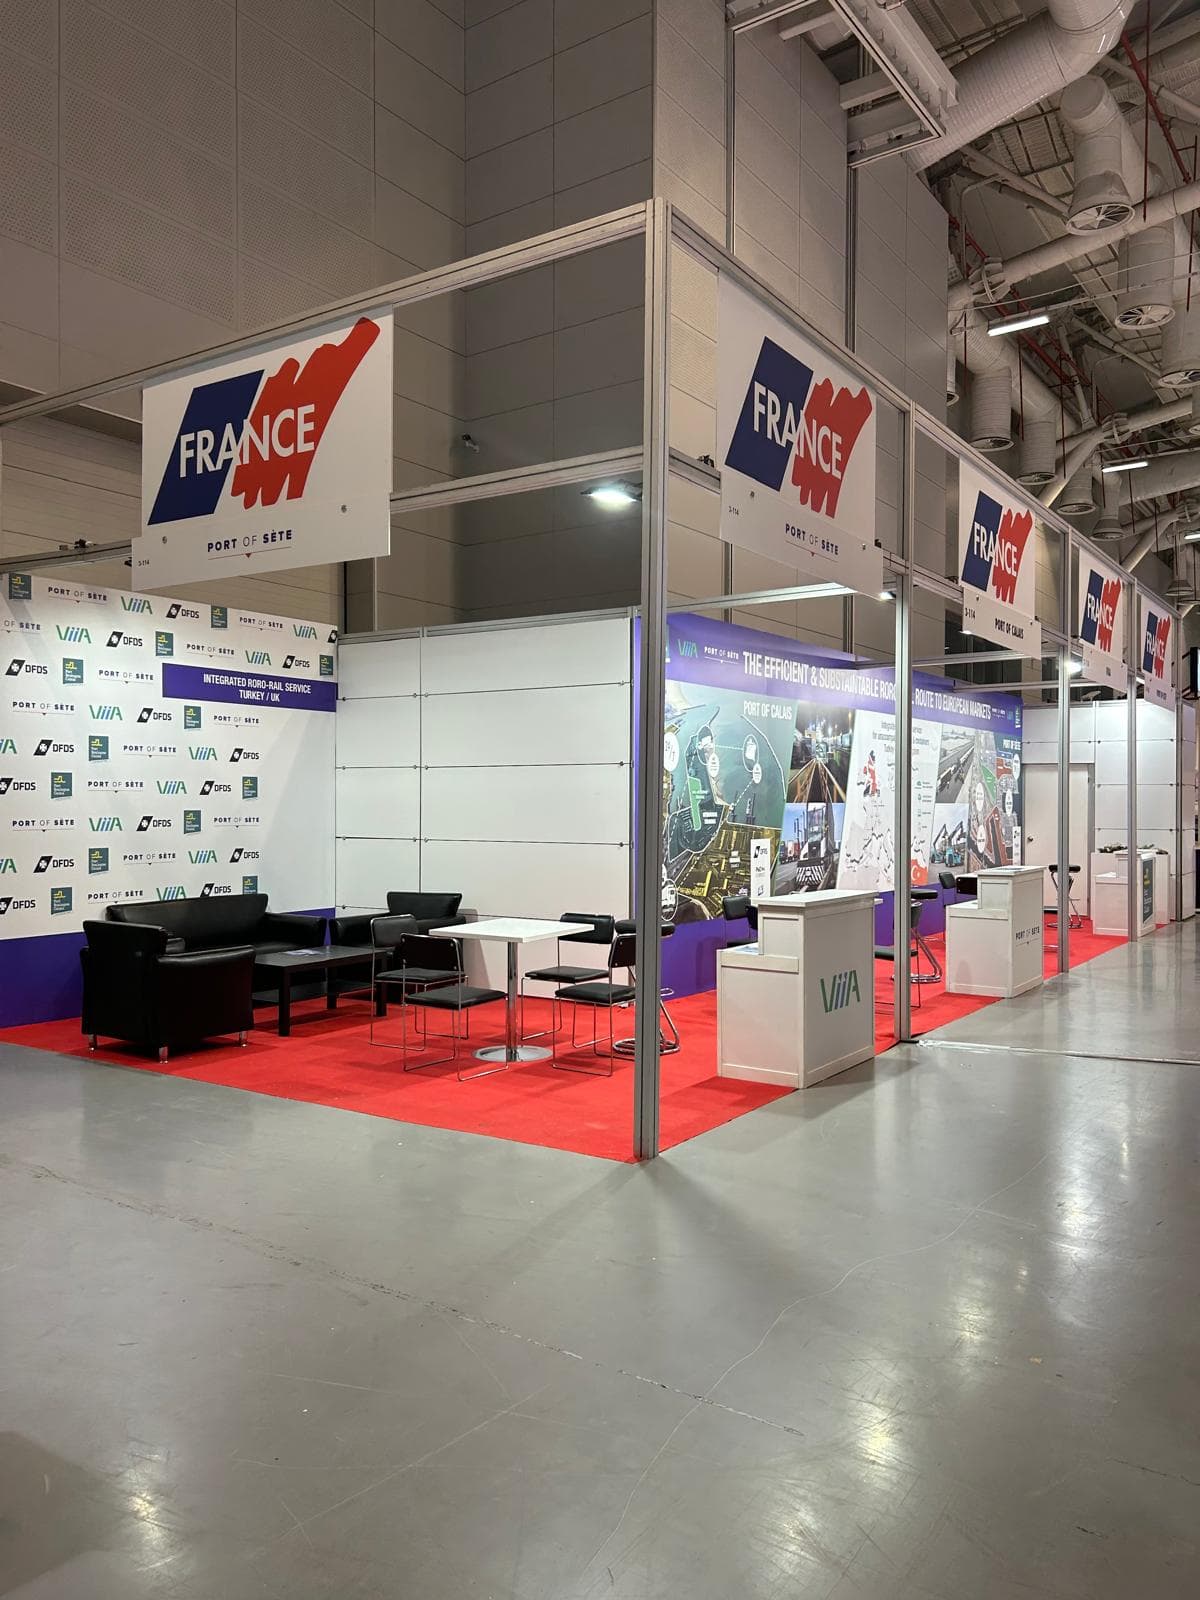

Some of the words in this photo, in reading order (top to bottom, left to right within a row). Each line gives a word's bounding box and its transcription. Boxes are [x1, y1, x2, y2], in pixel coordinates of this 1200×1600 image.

[753, 380, 842, 481] FRANCE
[179, 404, 315, 478] FRANCE
[785, 523, 805, 541] PORT
[809, 534, 818, 546] OF
[207, 538, 238, 553] PORT
[243, 536, 258, 547] OF
[262, 529, 293, 544] SÈTE
[974, 522, 1018, 577] FRANCE
[48, 586, 70, 596] PORT
[181, 609, 200, 619] DFDS
[1087, 592, 1112, 631] FRANCE
[995, 618, 1006, 633] PORT
[1006, 622, 1011, 634] OF
[1012, 625, 1024, 640] CALAIS
[123, 636, 143, 647] DFDS
[1146, 631, 1165, 661] FRANCE
[187, 643, 205, 651] PORT
[704, 646, 718, 655] PORT
[25, 664, 48, 674] DFDS
[295, 660, 310, 668] DFDS
[203, 674, 246, 687] INTEGRATED
[247, 678, 284, 691] RORO-RAIL
[285, 682, 312, 694] SERVICE
[743, 651, 762, 677] THE
[764, 656, 809, 685] EFFICIENT
[810, 666, 818, 686] &
[915, 688, 934, 708] ROUTE
[935, 693, 942, 710] TO
[943, 694, 969, 716] EUROPEAN
[970, 700, 992, 720] MARKETS
[239, 689, 265, 701] TURKEY
[271, 693, 280, 702] UK
[12, 701, 36, 709] PORT
[743, 700, 760, 717] PORT
[761, 703, 770, 718] OF
[770, 704, 792, 720] CALAIS
[153, 712, 172, 721] DFDS
[52, 744, 74, 753] DFDS
[243, 752, 260, 760] DFDS
[13, 782, 36, 790] DFDS
[214, 784, 232, 792] DFDS
[152, 819, 172, 828] DFDS
[52, 859, 75, 868] DFDS
[214, 885, 232, 894] DFDS
[12, 900, 36, 910] DFDS
